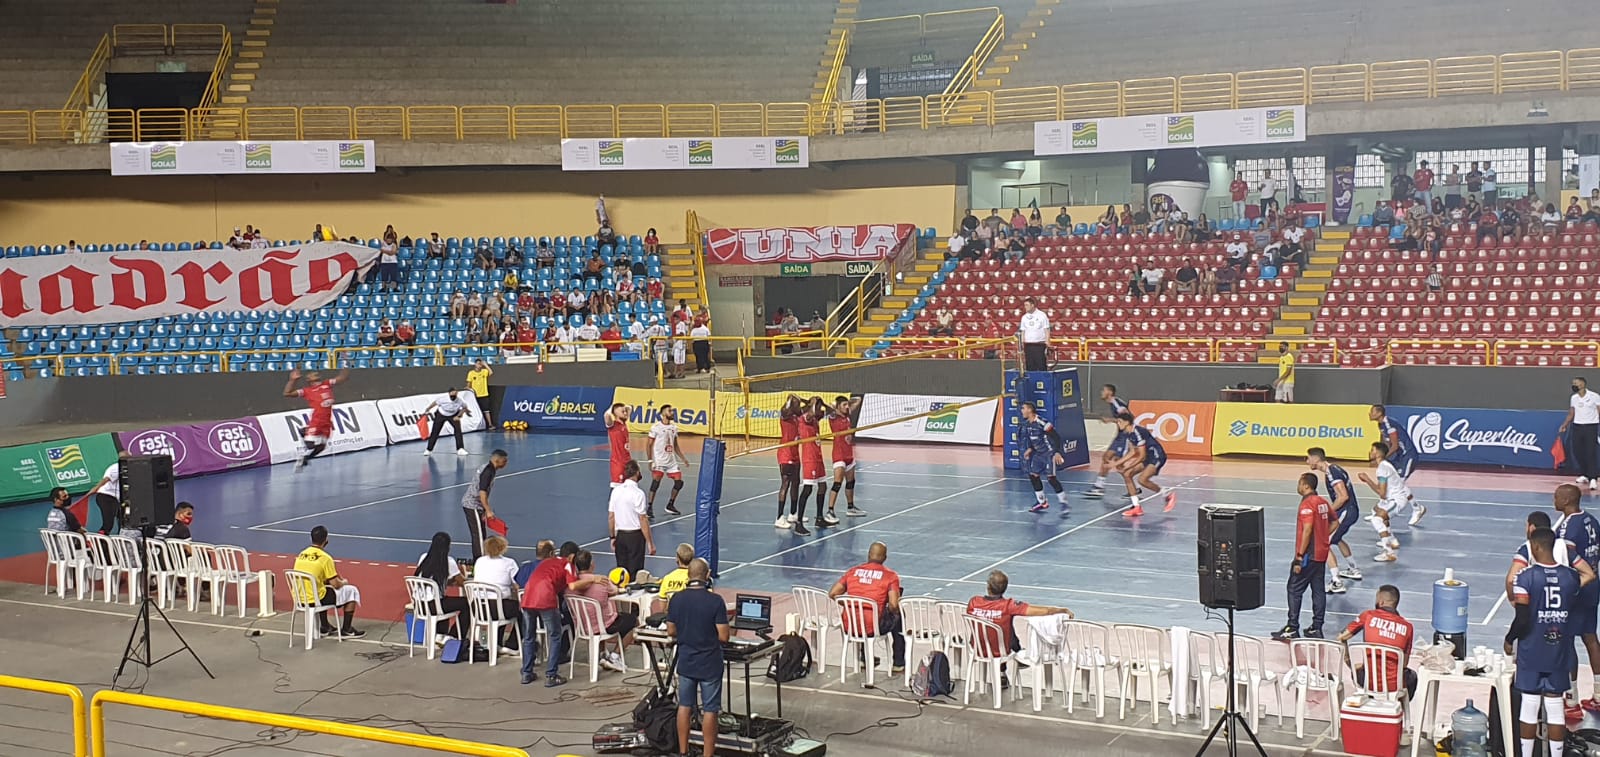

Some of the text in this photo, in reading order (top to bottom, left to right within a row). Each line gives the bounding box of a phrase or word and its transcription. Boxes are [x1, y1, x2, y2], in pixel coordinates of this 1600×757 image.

[784, 264, 809, 273] SAÍDA
[848, 262, 871, 274] SAÍDA
[513, 399, 596, 414] VÔLEI BRASIL
[1133, 412, 1204, 443] GOL
[1251, 423, 1364, 438] BANCO DO BRASIL
[1444, 419, 1540, 453] Superliga
[1544, 586, 1561, 608] 15
[1369, 616, 1408, 637] SUZANO
